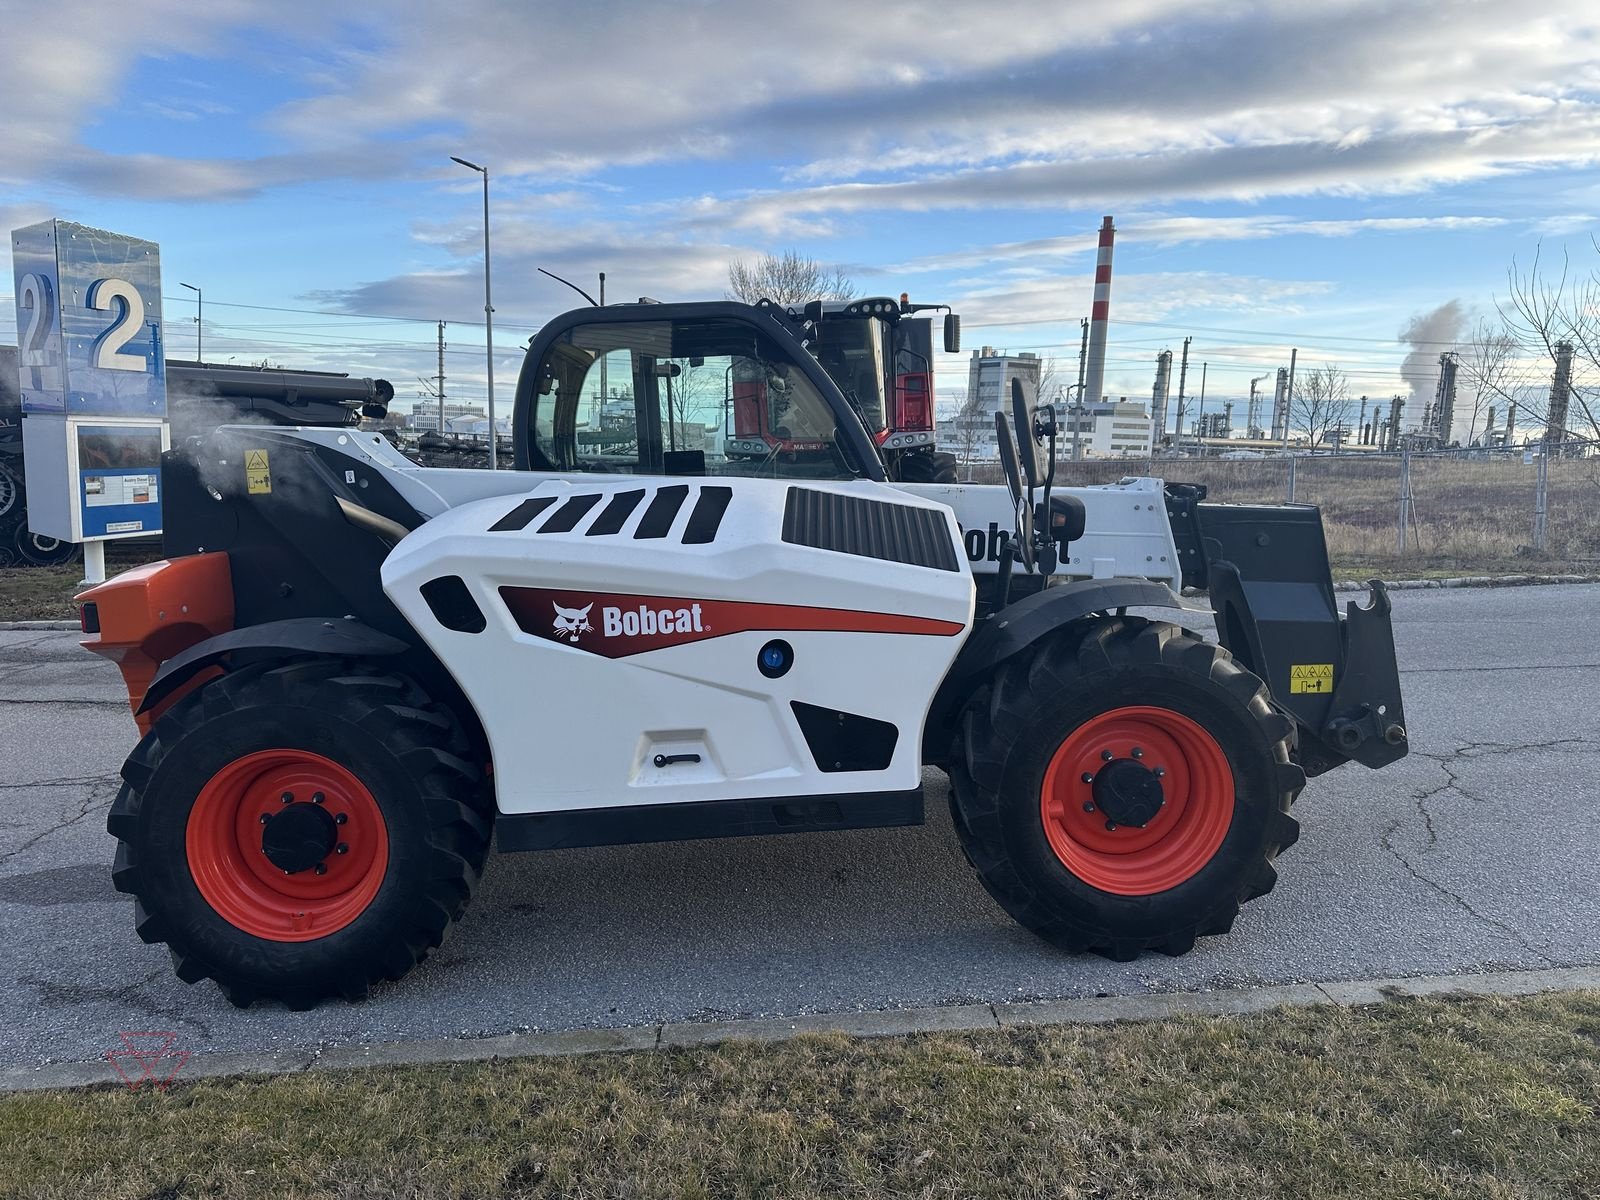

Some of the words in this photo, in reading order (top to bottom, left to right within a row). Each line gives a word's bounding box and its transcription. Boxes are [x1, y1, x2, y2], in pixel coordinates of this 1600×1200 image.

[94, 278, 147, 372] 2
[957, 521, 1070, 565] obt
[602, 603, 702, 637] Bobcat
